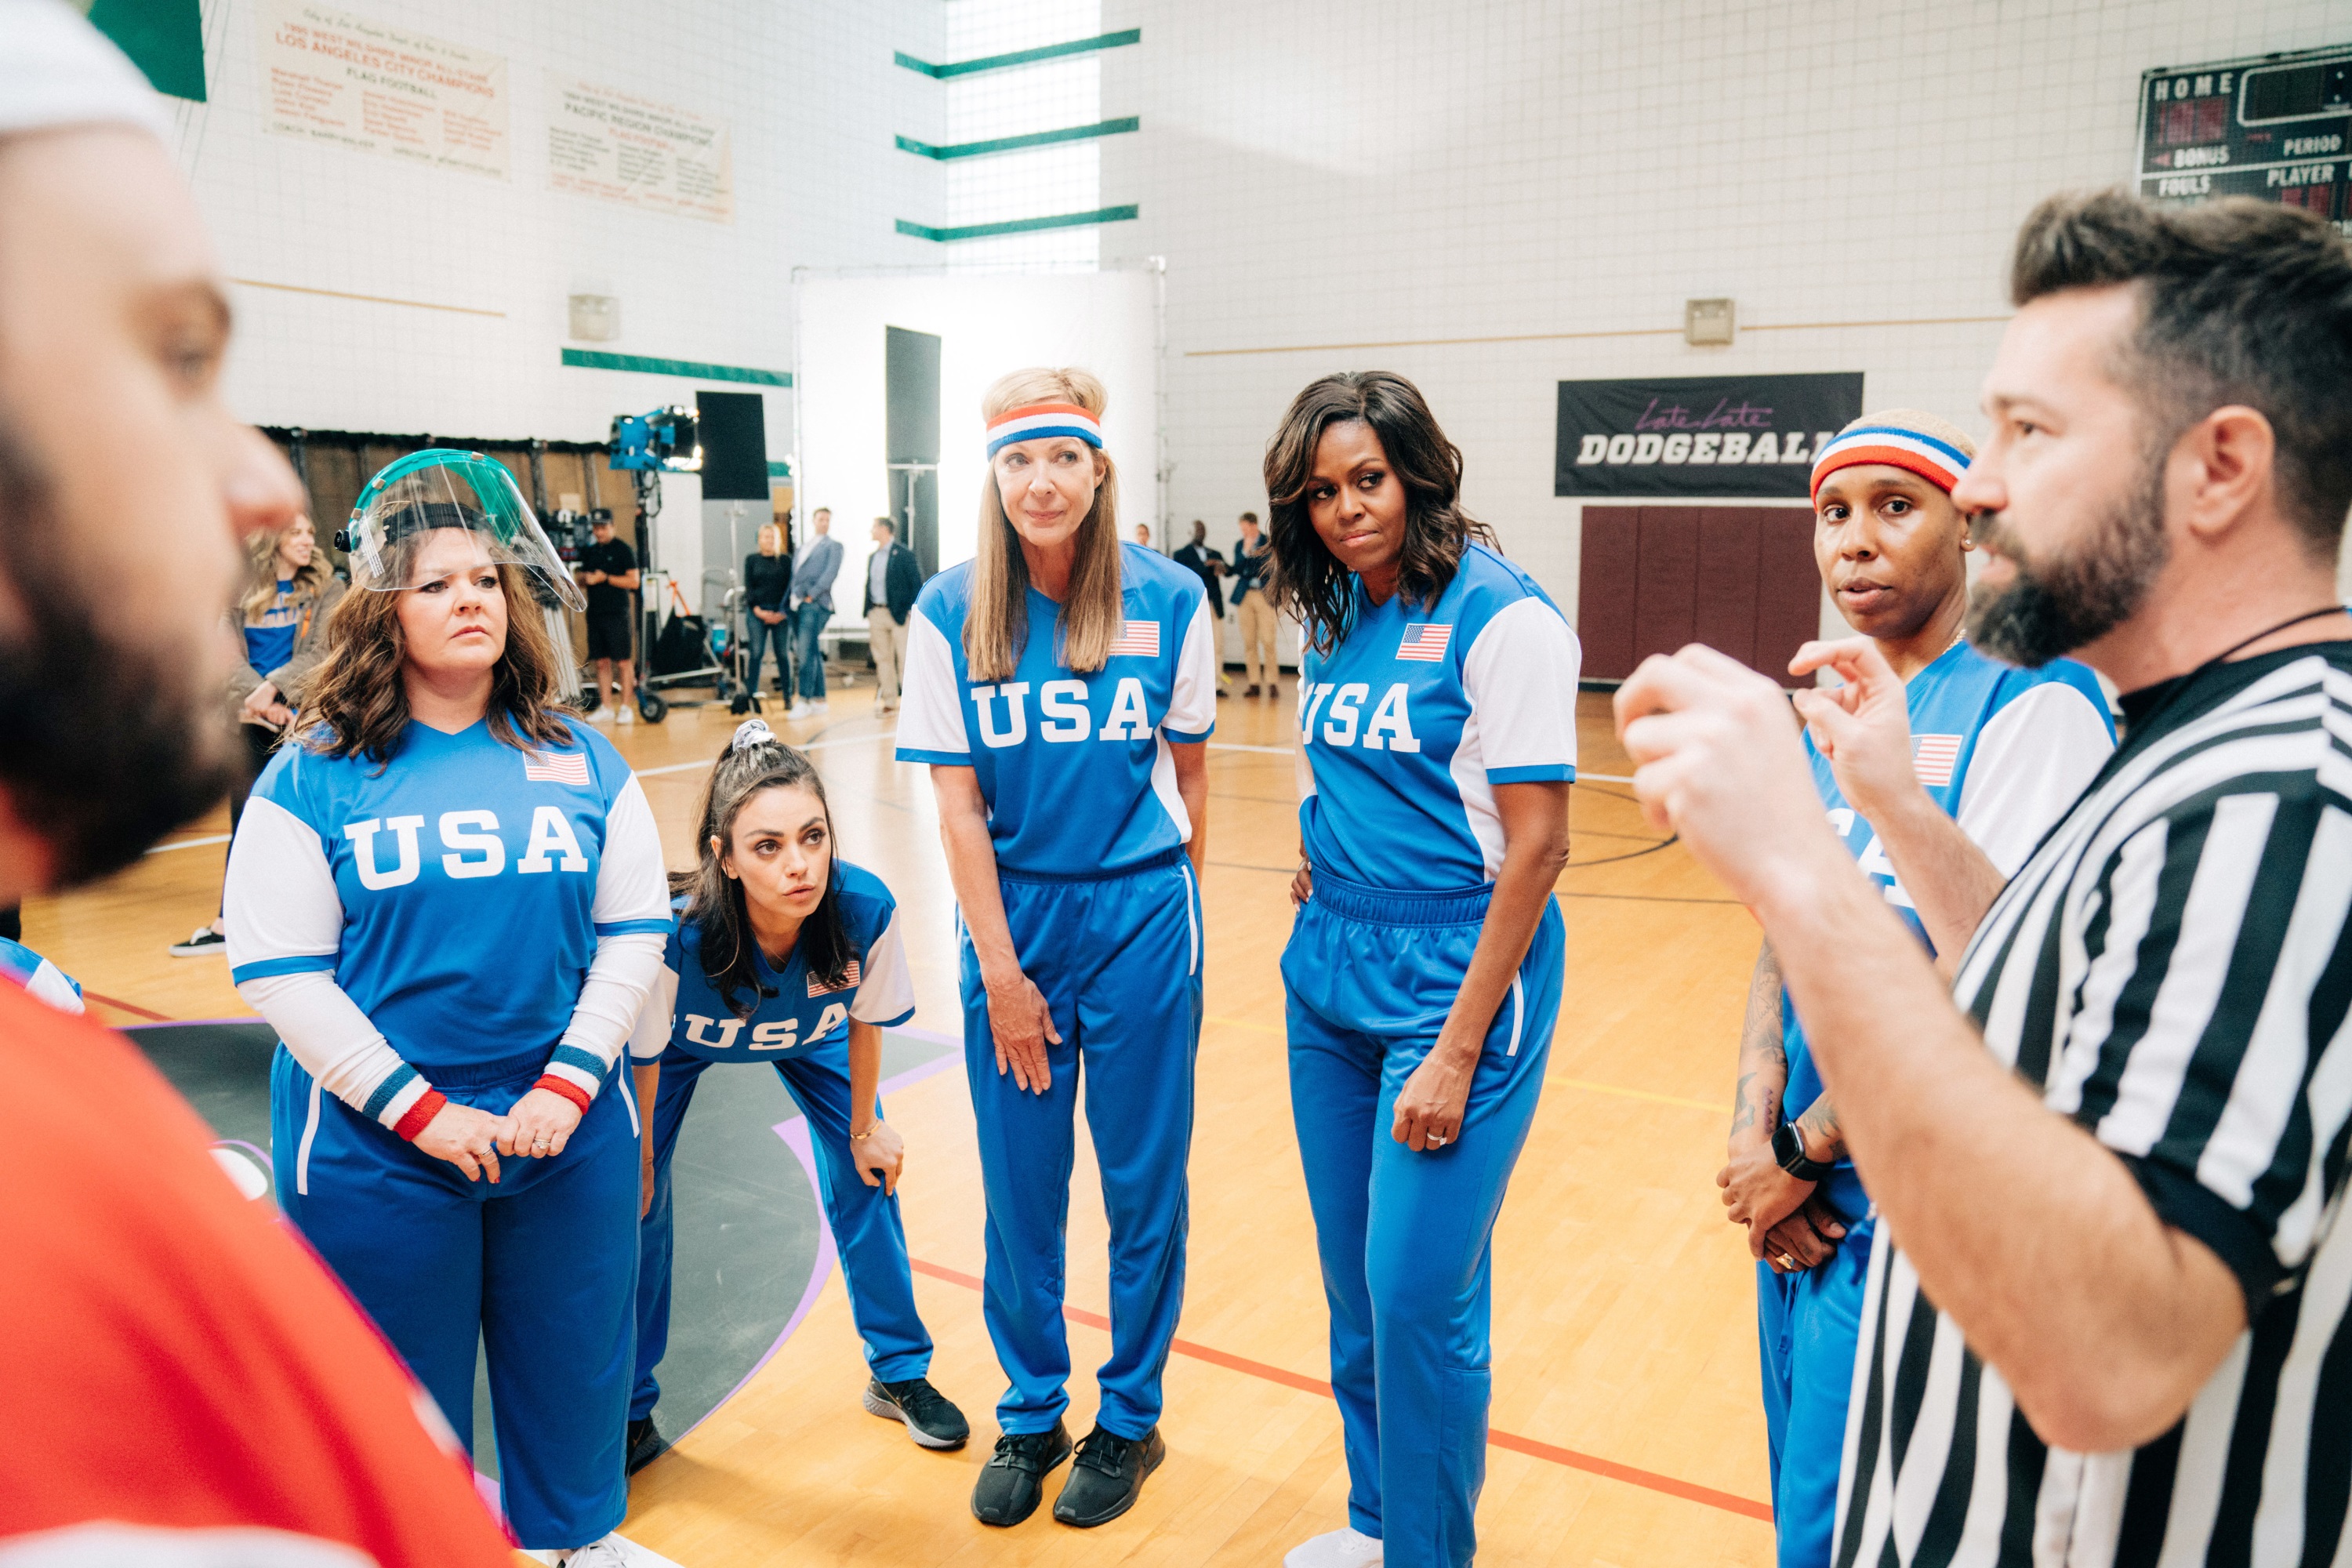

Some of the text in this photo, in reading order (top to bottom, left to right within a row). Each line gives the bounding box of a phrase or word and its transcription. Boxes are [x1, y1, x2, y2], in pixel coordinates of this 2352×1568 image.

[274, 30, 307, 50] LOS
[311, 41, 380, 68] ANGELES
[384, 59, 415, 76] CITY
[416, 67, 496, 99] CHAMPIONS
[347, 66, 438, 99] FLAG FOOTBALL
[2154, 71, 2233, 101] HOME
[564, 102, 608, 123] PACIFIC
[610, 114, 652, 132] REGION
[2174, 144, 2230, 169] BONUS
[2283, 133, 2342, 157] PERIOD
[2158, 174, 2212, 197] FOULS
[2266, 163, 2336, 188] PLAYER
[971, 677, 1154, 748] USA
[1301, 682, 1421, 753] USA
[343, 806, 589, 891] USA
[684, 1002, 848, 1051] USA
